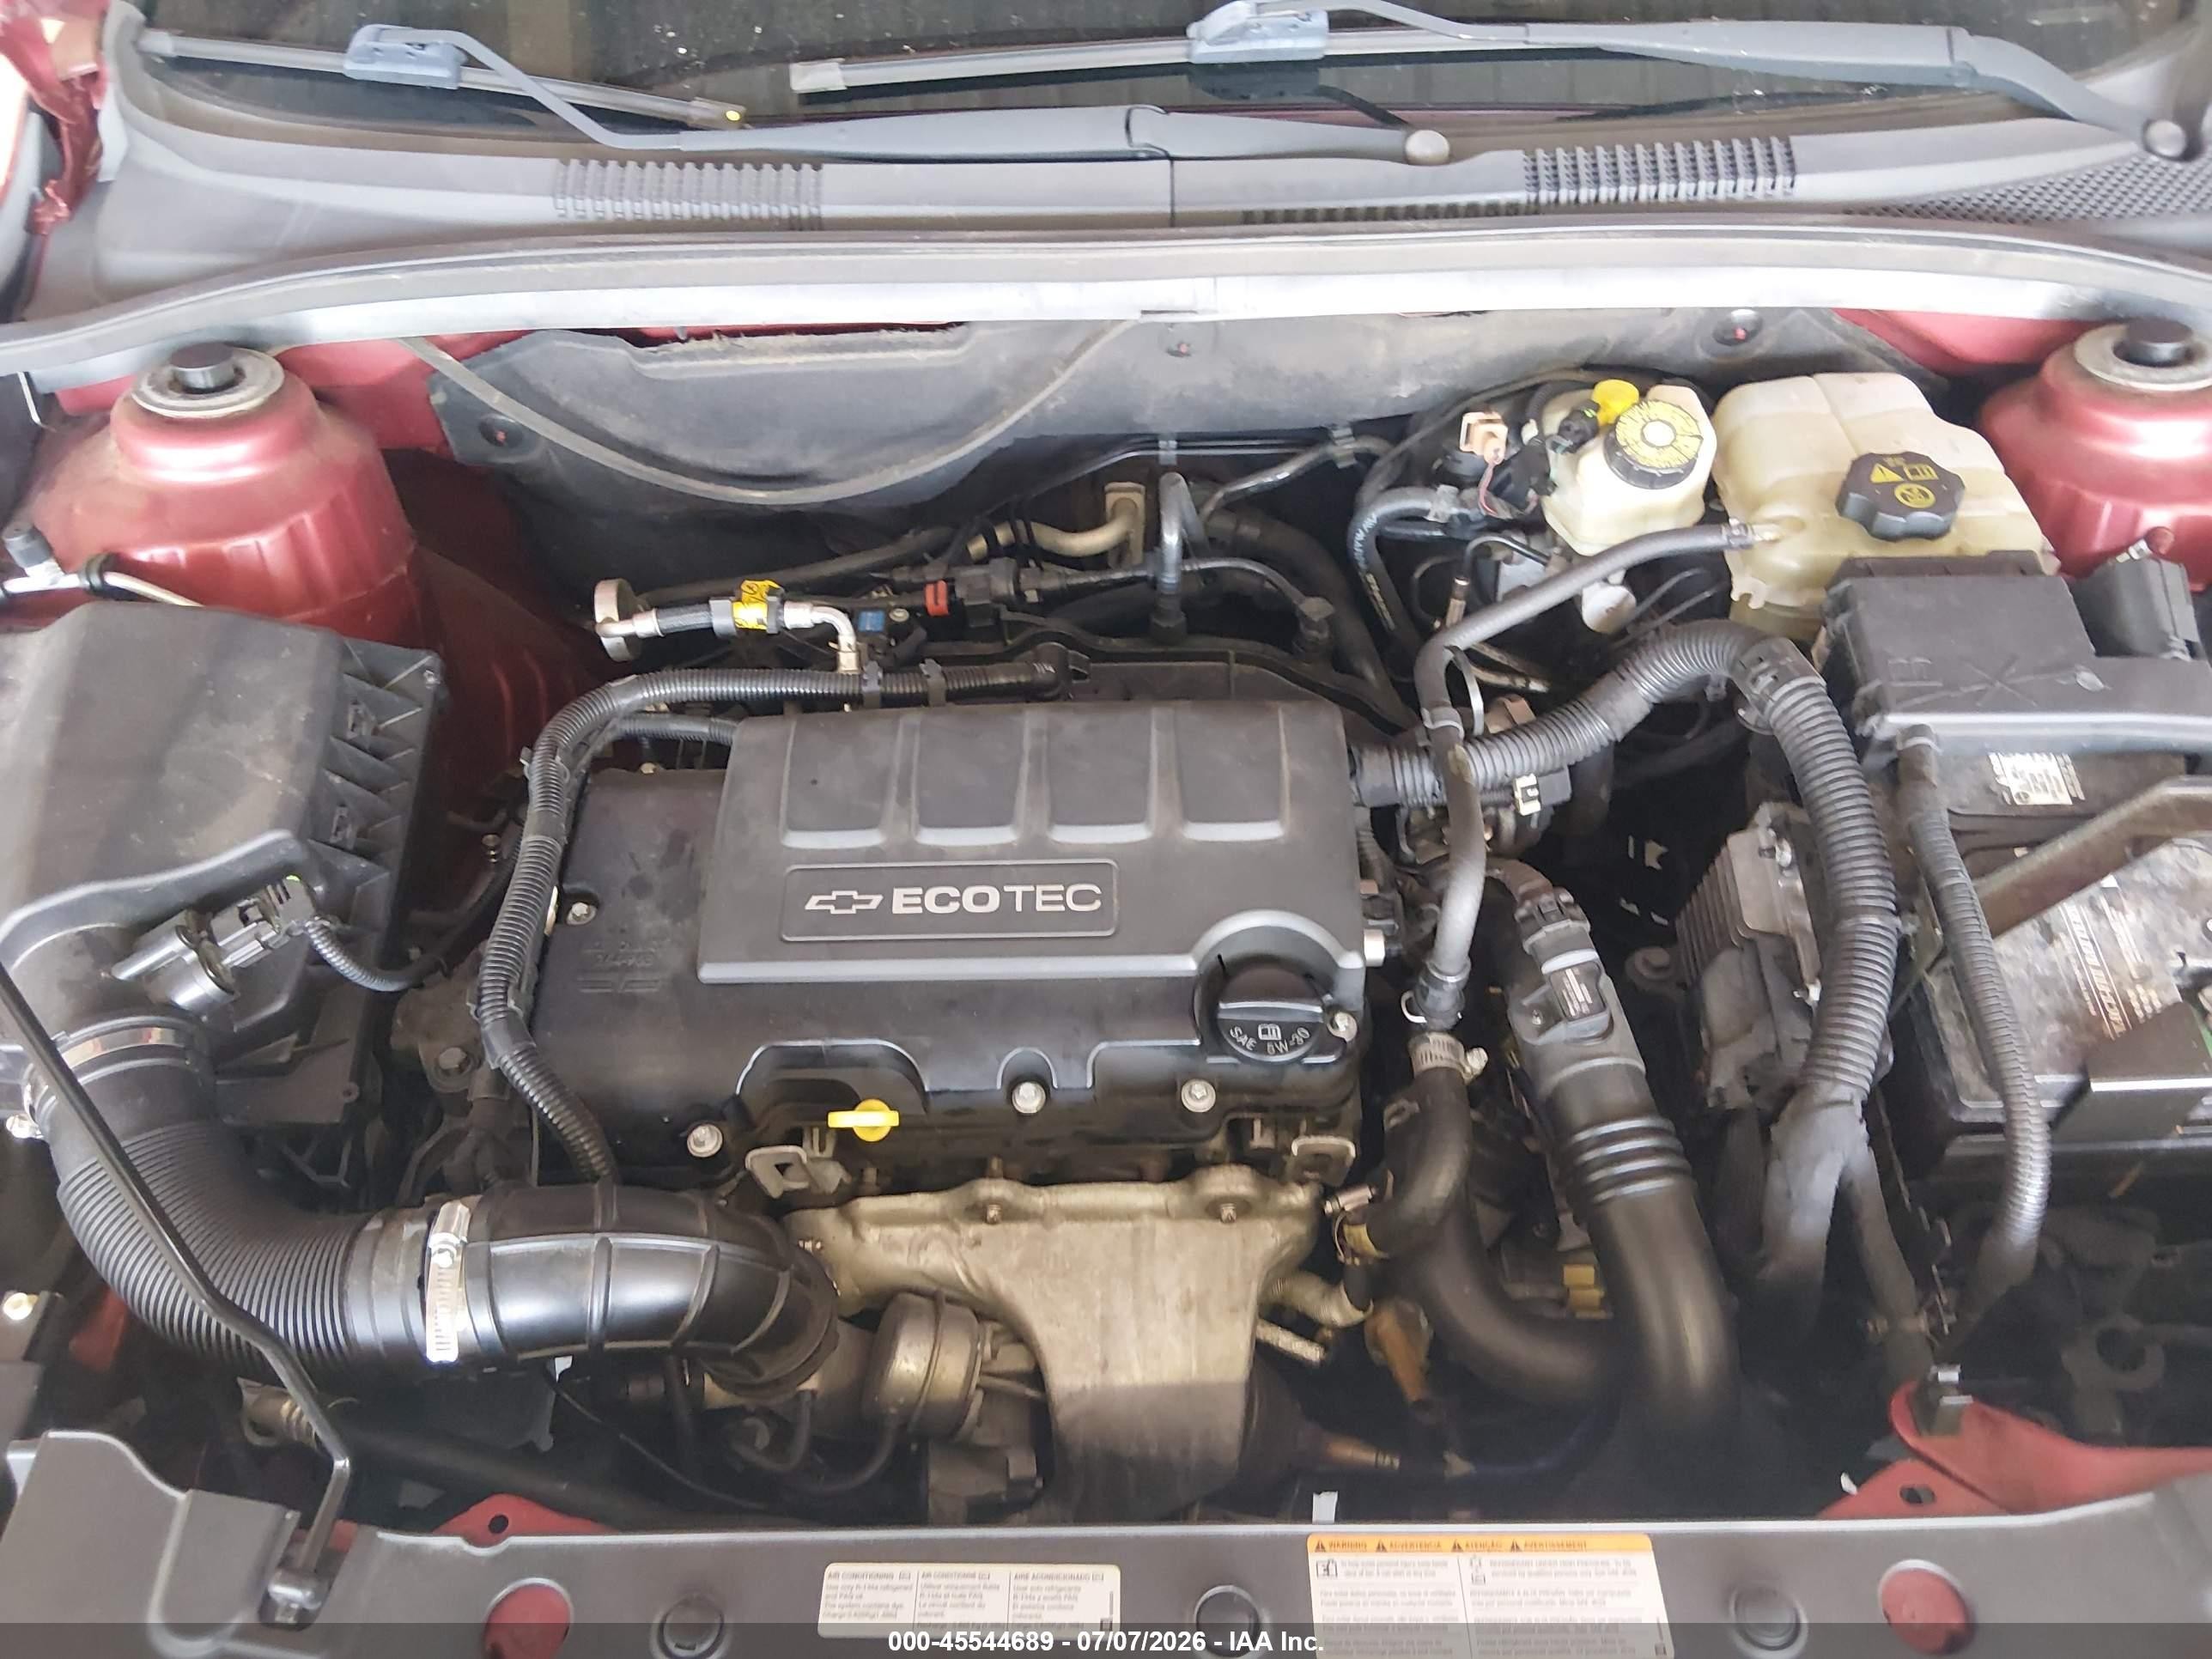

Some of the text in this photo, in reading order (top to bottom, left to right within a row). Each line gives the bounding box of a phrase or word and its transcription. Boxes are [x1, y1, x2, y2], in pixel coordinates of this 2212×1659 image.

[891, 883, 1103, 915] ECOTEC
[1230, 1026, 1257, 1050] SAE
[1328, 1540, 1368, 1550] WARNING
